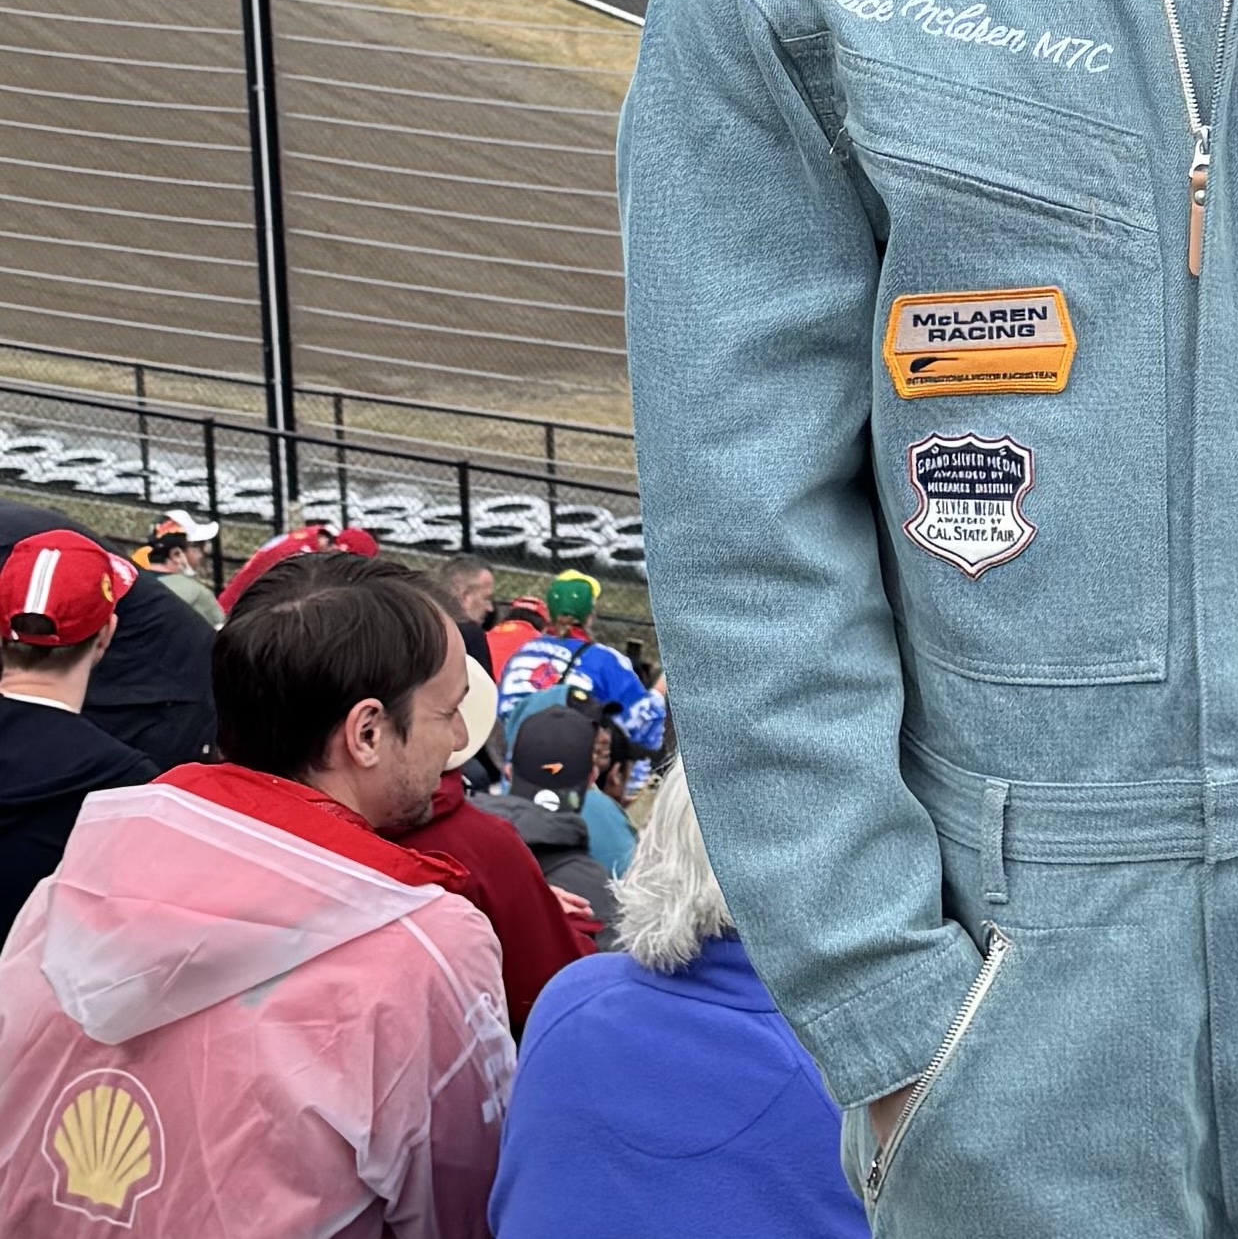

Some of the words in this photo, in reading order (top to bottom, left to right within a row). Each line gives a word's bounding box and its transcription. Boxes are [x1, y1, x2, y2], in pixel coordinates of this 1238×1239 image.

[1033, 30, 1114, 74] M7C
[912, 305, 1048, 328] McLAREN
[927, 323, 1036, 343] RACING
[951, 452, 984, 467] SILVER
[986, 456, 1022, 478] MEDAL
[935, 500, 970, 515] SILVER
[974, 501, 1006, 517] MEDAL
[953, 525, 988, 542] STATE
